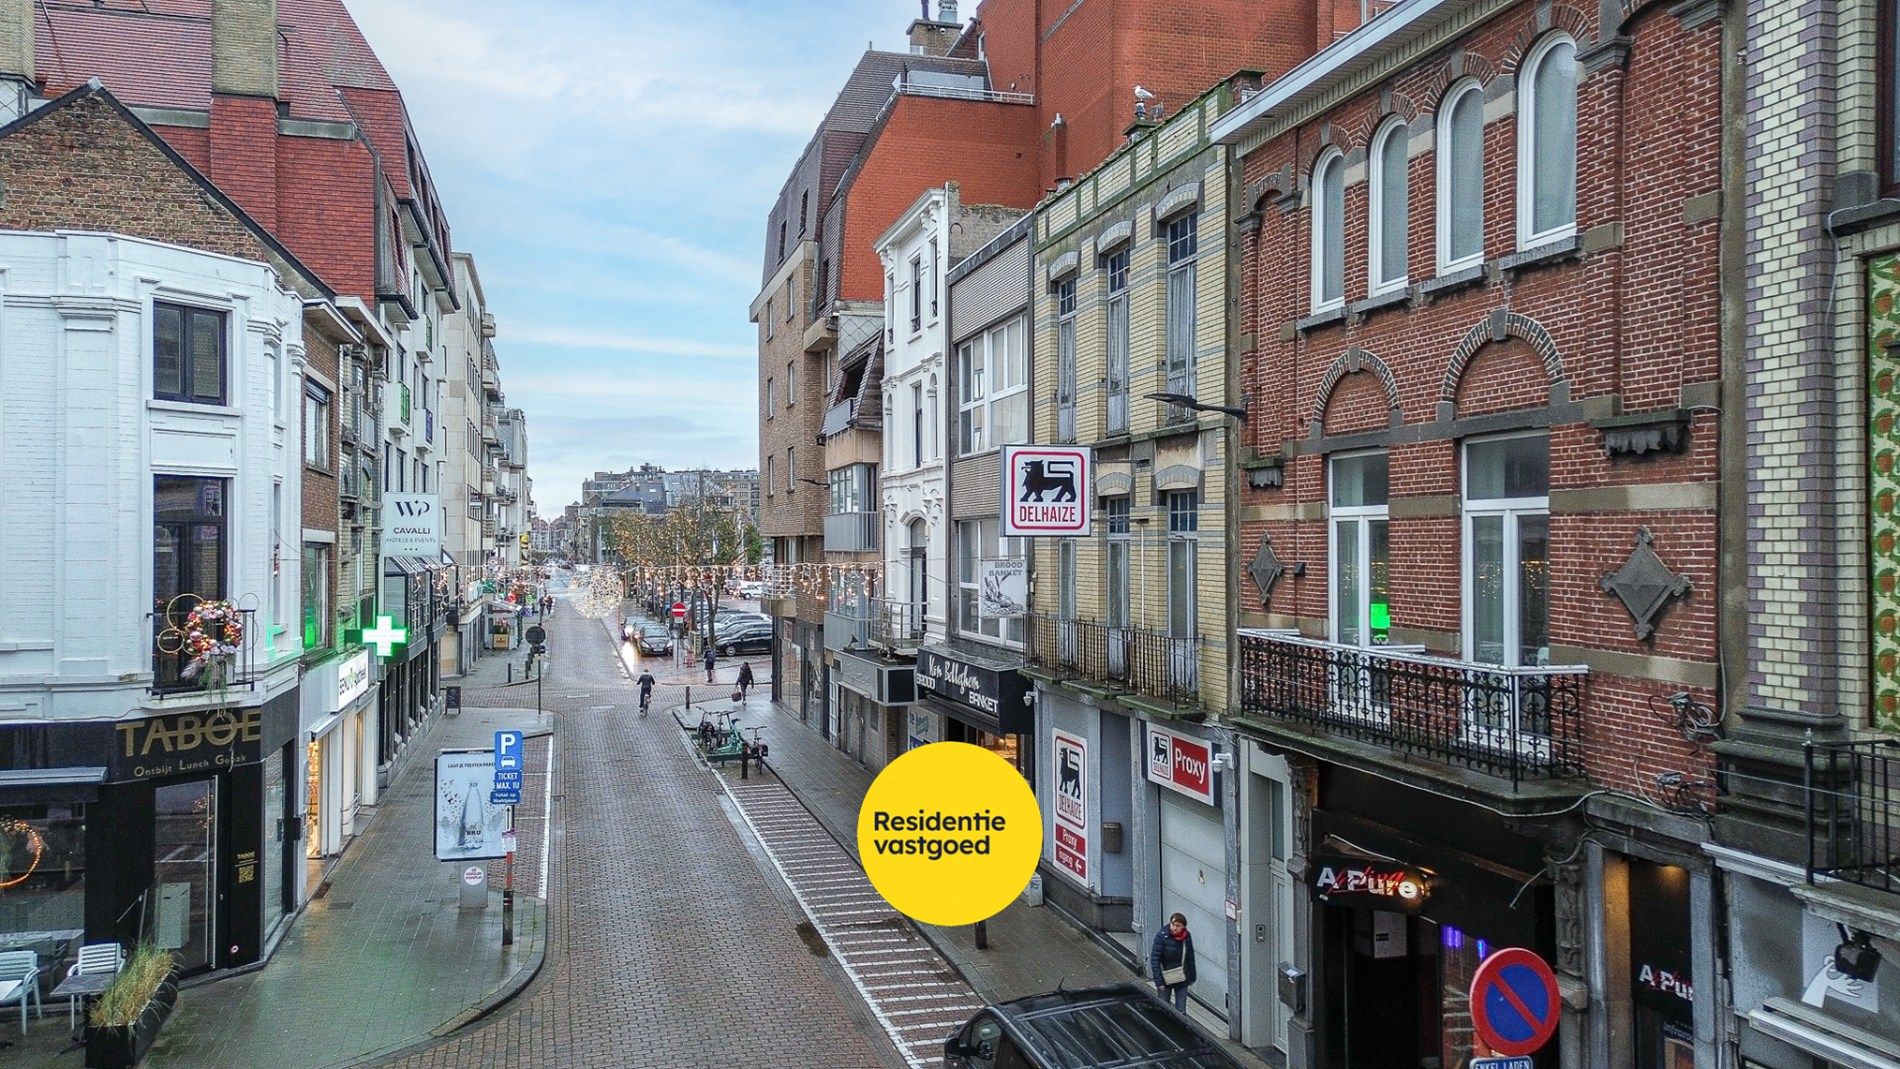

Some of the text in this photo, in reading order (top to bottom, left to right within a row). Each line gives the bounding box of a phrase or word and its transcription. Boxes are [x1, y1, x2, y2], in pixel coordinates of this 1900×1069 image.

[1019, 505, 1076, 523] DELHAIZE
[393, 527, 431, 535] CAVALLI
[988, 569, 1022, 577] BANKET
[994, 561, 1023, 569] BROOD
[916, 672, 936, 690] BROOD
[969, 690, 998, 714] BANKET
[115, 708, 261, 757] TABOE
[501, 734, 516, 755] P
[134, 765, 172, 777] Ontbijt
[179, 758, 209, 770] Lunch
[1175, 747, 1206, 784] Proxy
[1059, 794, 1082, 821] DELHAIZE
[1062, 828, 1078, 851] Proxy
[1347, 869, 1418, 899] Pure
